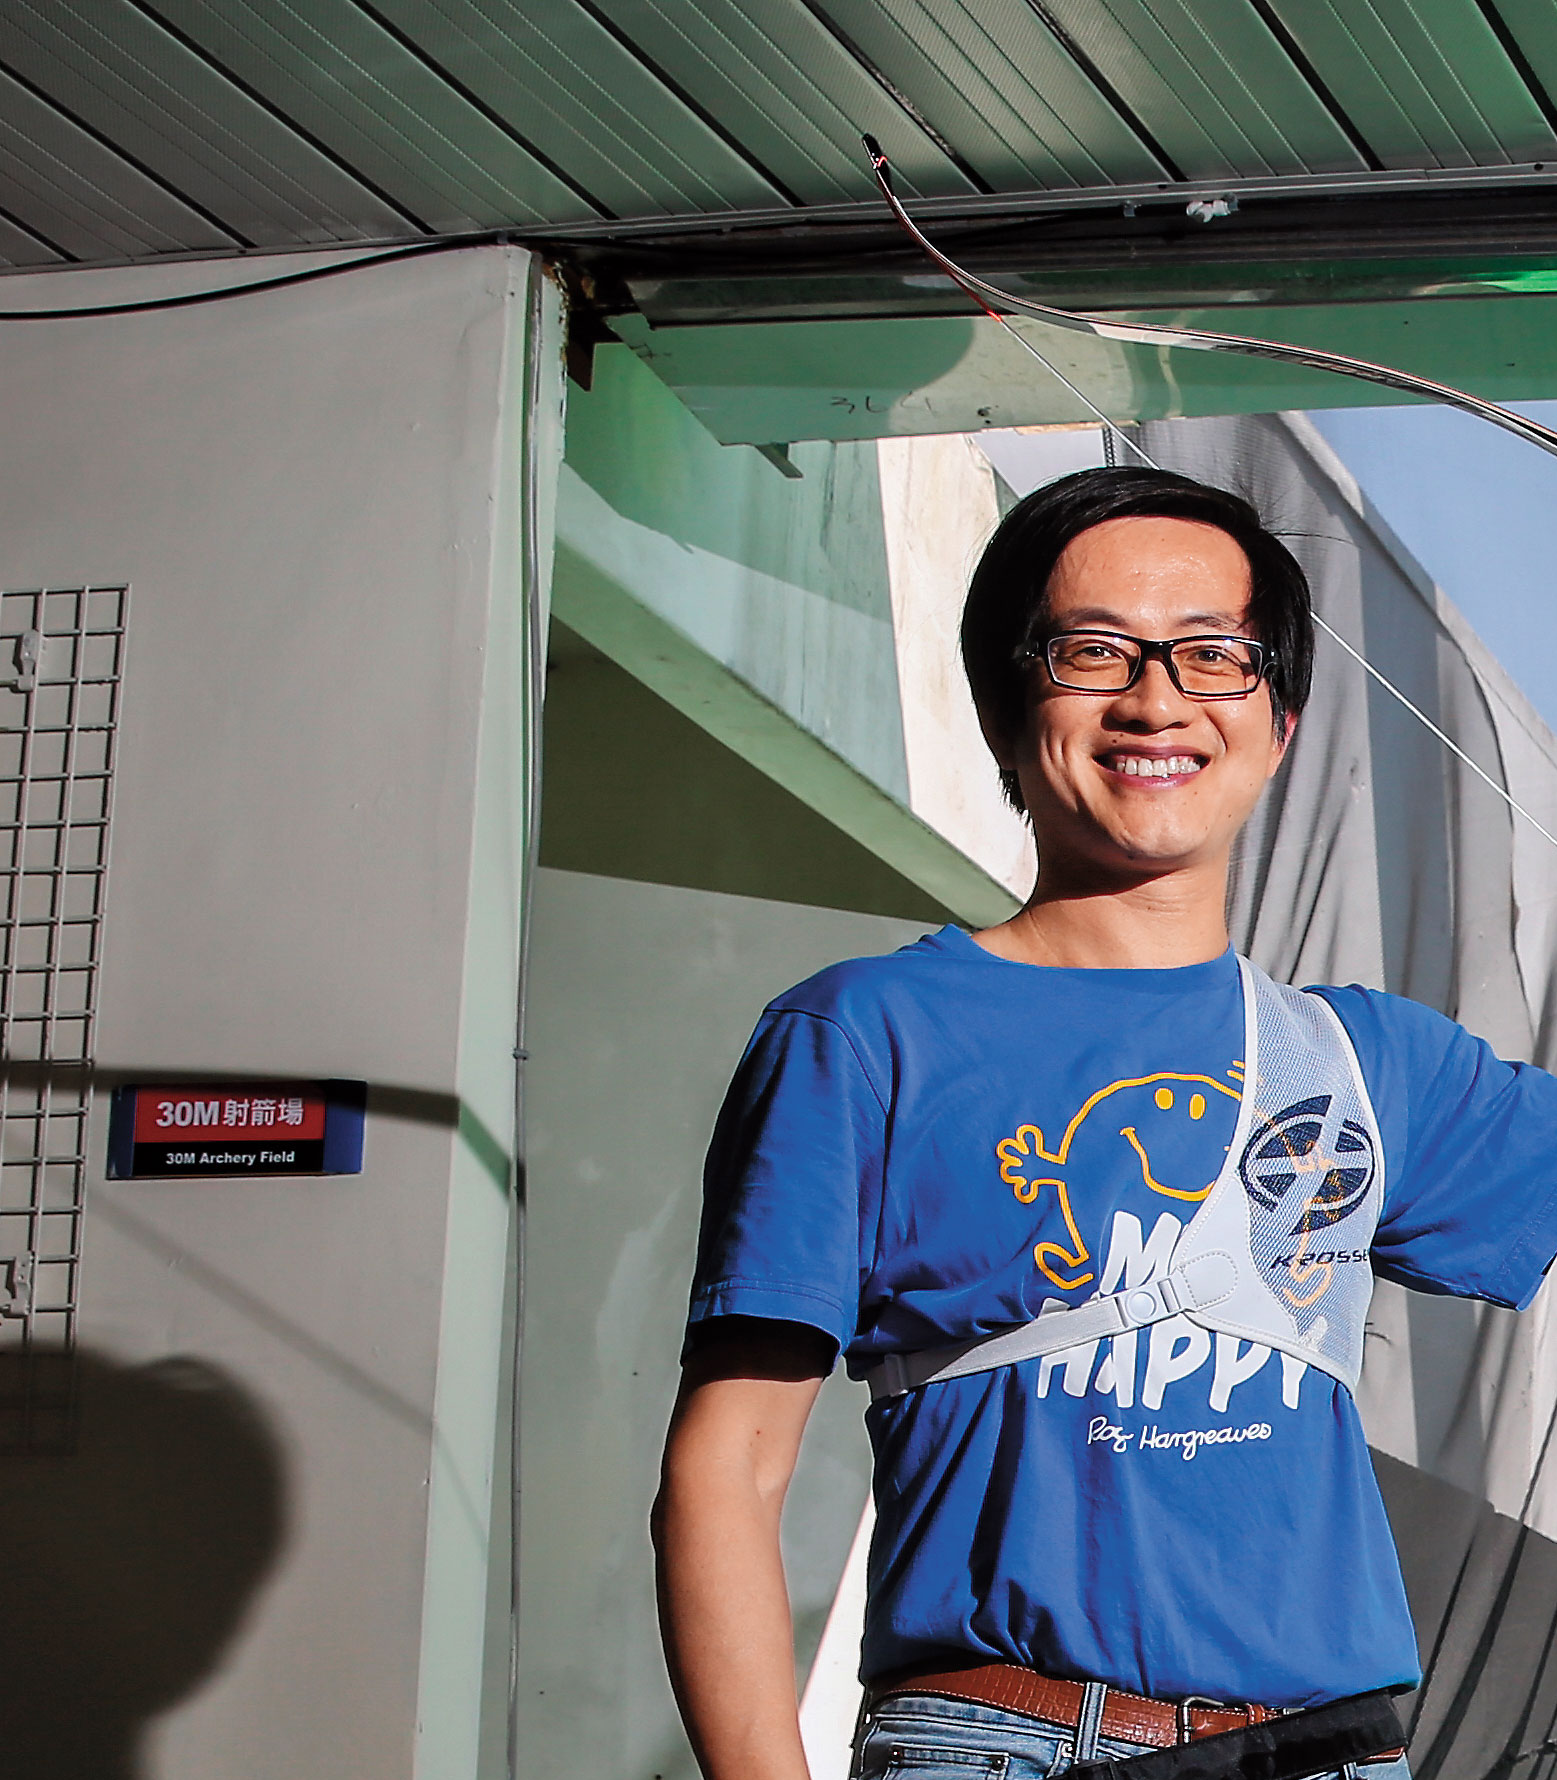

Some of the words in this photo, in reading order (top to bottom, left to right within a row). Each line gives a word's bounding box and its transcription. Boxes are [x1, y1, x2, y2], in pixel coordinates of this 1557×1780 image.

[155, 1098, 304, 1128] 30M射箭場
[165, 1152, 196, 1165] 30M
[199, 1151, 256, 1166] Archery
[260, 1151, 296, 1163] Field
[1139, 1422, 1272, 1461] Hargreaves
